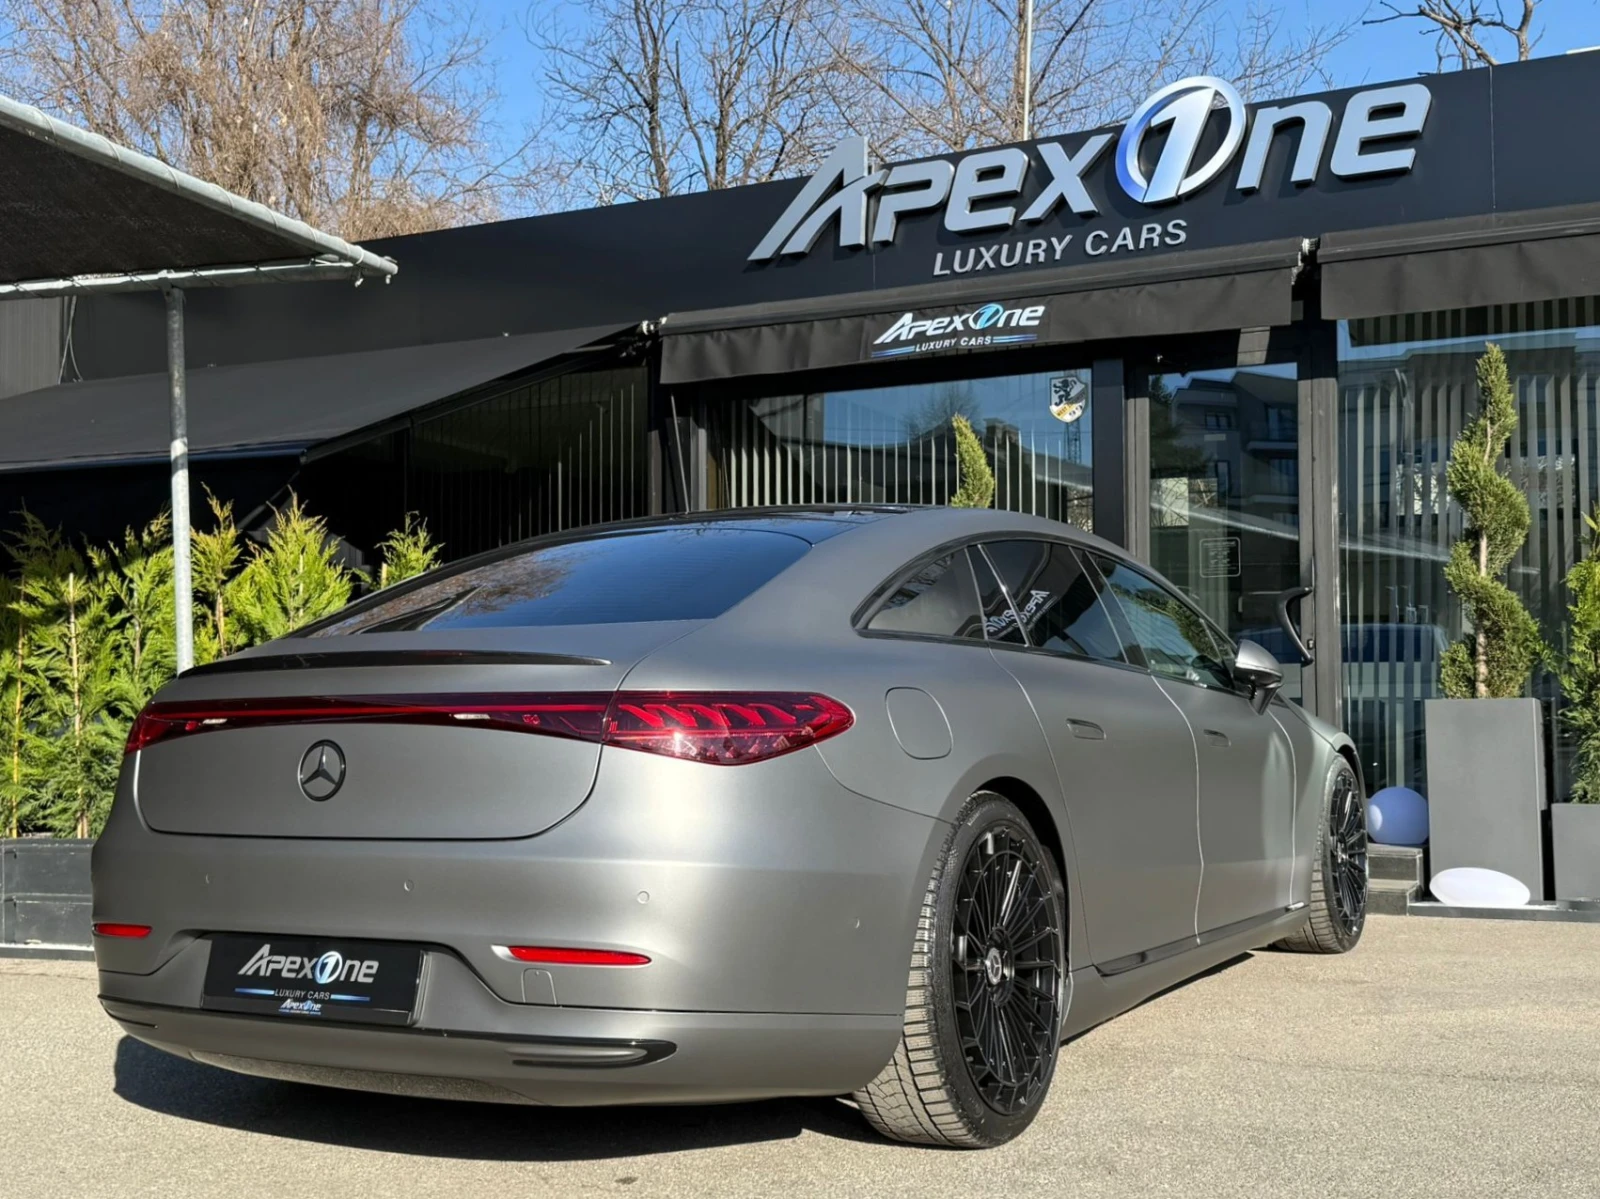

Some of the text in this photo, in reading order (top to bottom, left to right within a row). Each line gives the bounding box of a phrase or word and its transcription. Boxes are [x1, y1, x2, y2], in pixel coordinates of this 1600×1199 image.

[932, 218, 1188, 277] LUXURY CARS
[915, 335, 992, 352] LUXURY CARS
[274, 988, 330, 1000] LUXURY CARS
